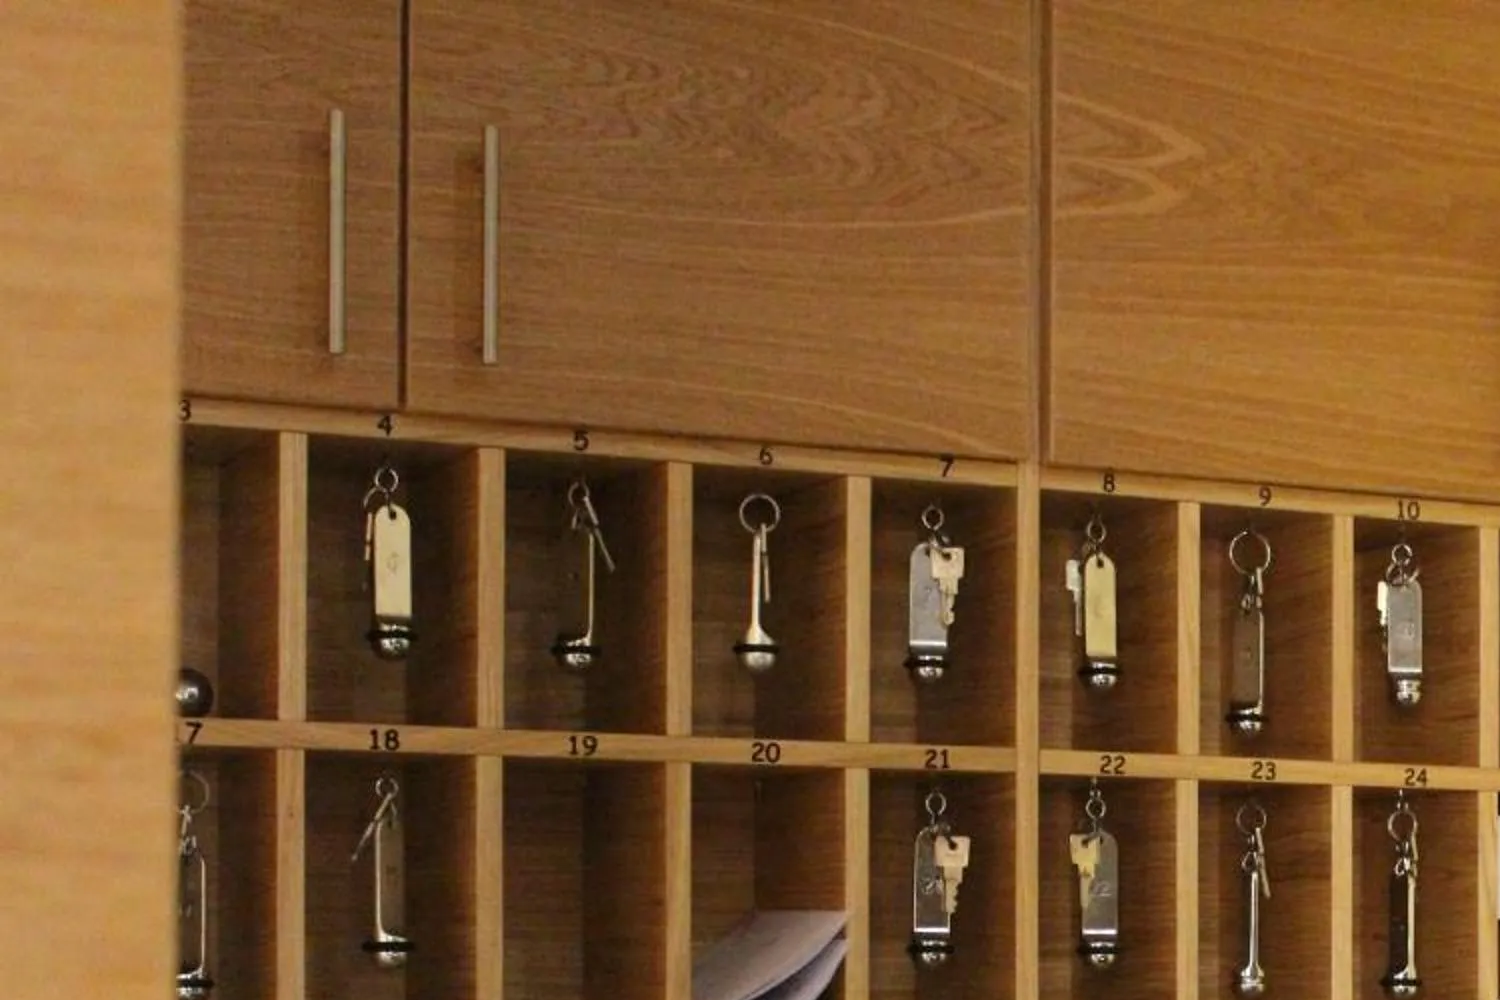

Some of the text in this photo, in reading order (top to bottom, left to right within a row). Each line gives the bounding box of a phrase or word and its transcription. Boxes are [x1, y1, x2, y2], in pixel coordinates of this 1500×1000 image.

[377, 414, 394, 436] 4
[573, 428, 589, 451] 5
[759, 448, 773, 466] 6
[939, 455, 955, 478] 7
[1102, 471, 1116, 491] 8
[1259, 486, 1273, 506] 9
[1396, 499, 1420, 520] 10
[368, 728, 401, 751] 18
[567, 735, 599, 756] 19
[751, 741, 782, 763] 20
[924, 748, 950, 769] 21
[1099, 755, 1126, 775] 22
[1251, 760, 1278, 781] 23
[1403, 767, 1427, 788] 24
